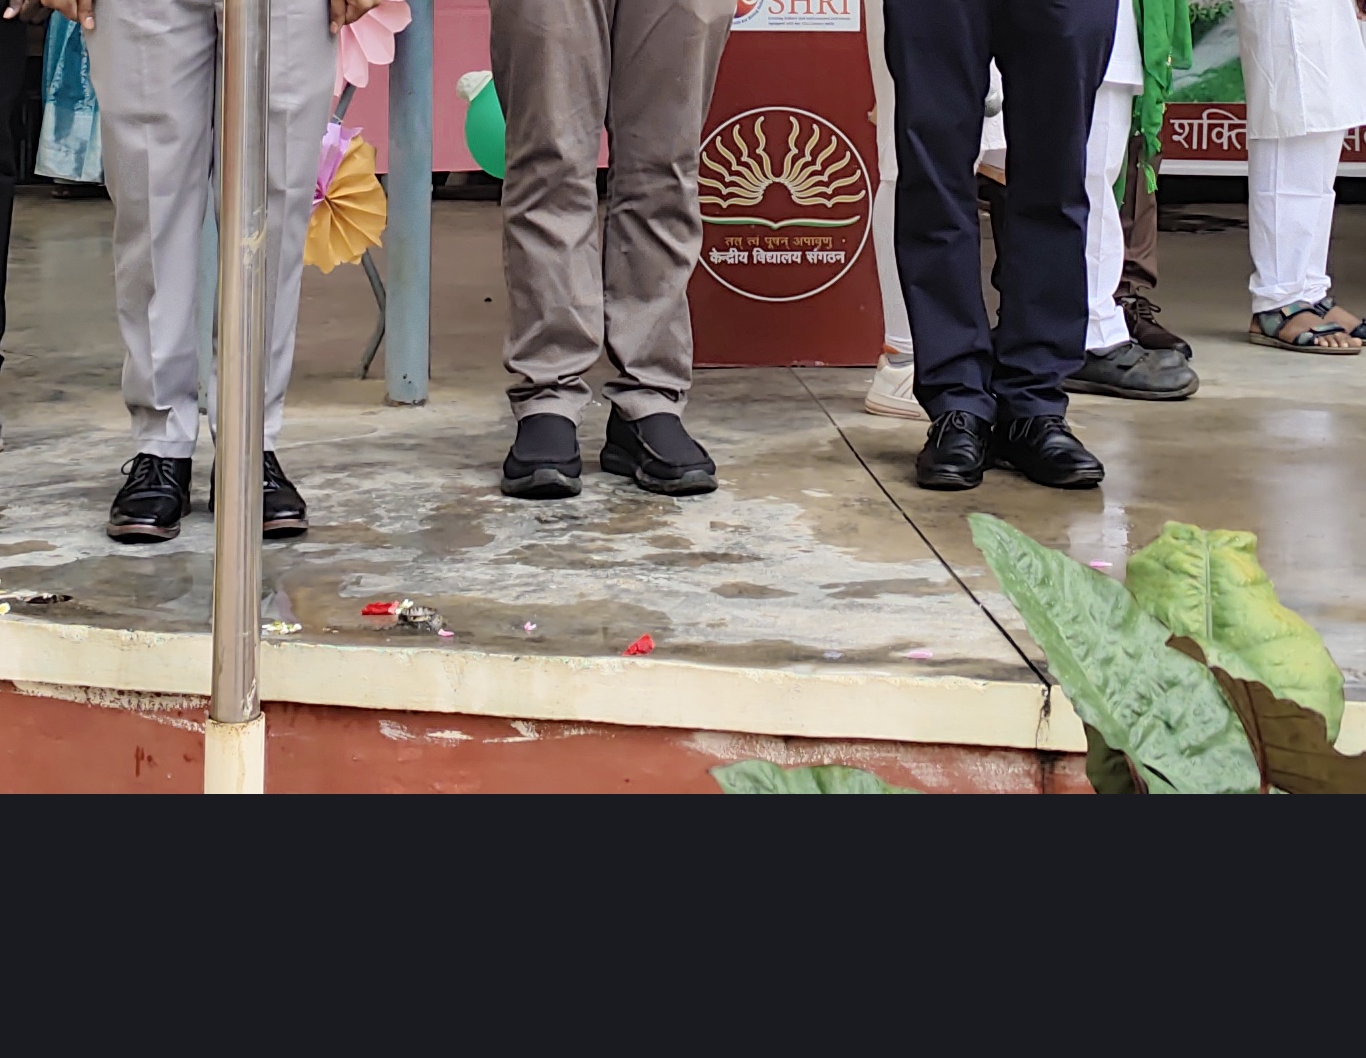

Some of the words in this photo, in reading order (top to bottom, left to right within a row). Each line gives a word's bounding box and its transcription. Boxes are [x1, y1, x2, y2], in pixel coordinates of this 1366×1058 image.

[709, 247, 748, 264] केन्द्रीय
[752, 247, 803, 264] विद्यालय
[805, 246, 846, 264] संगठन
